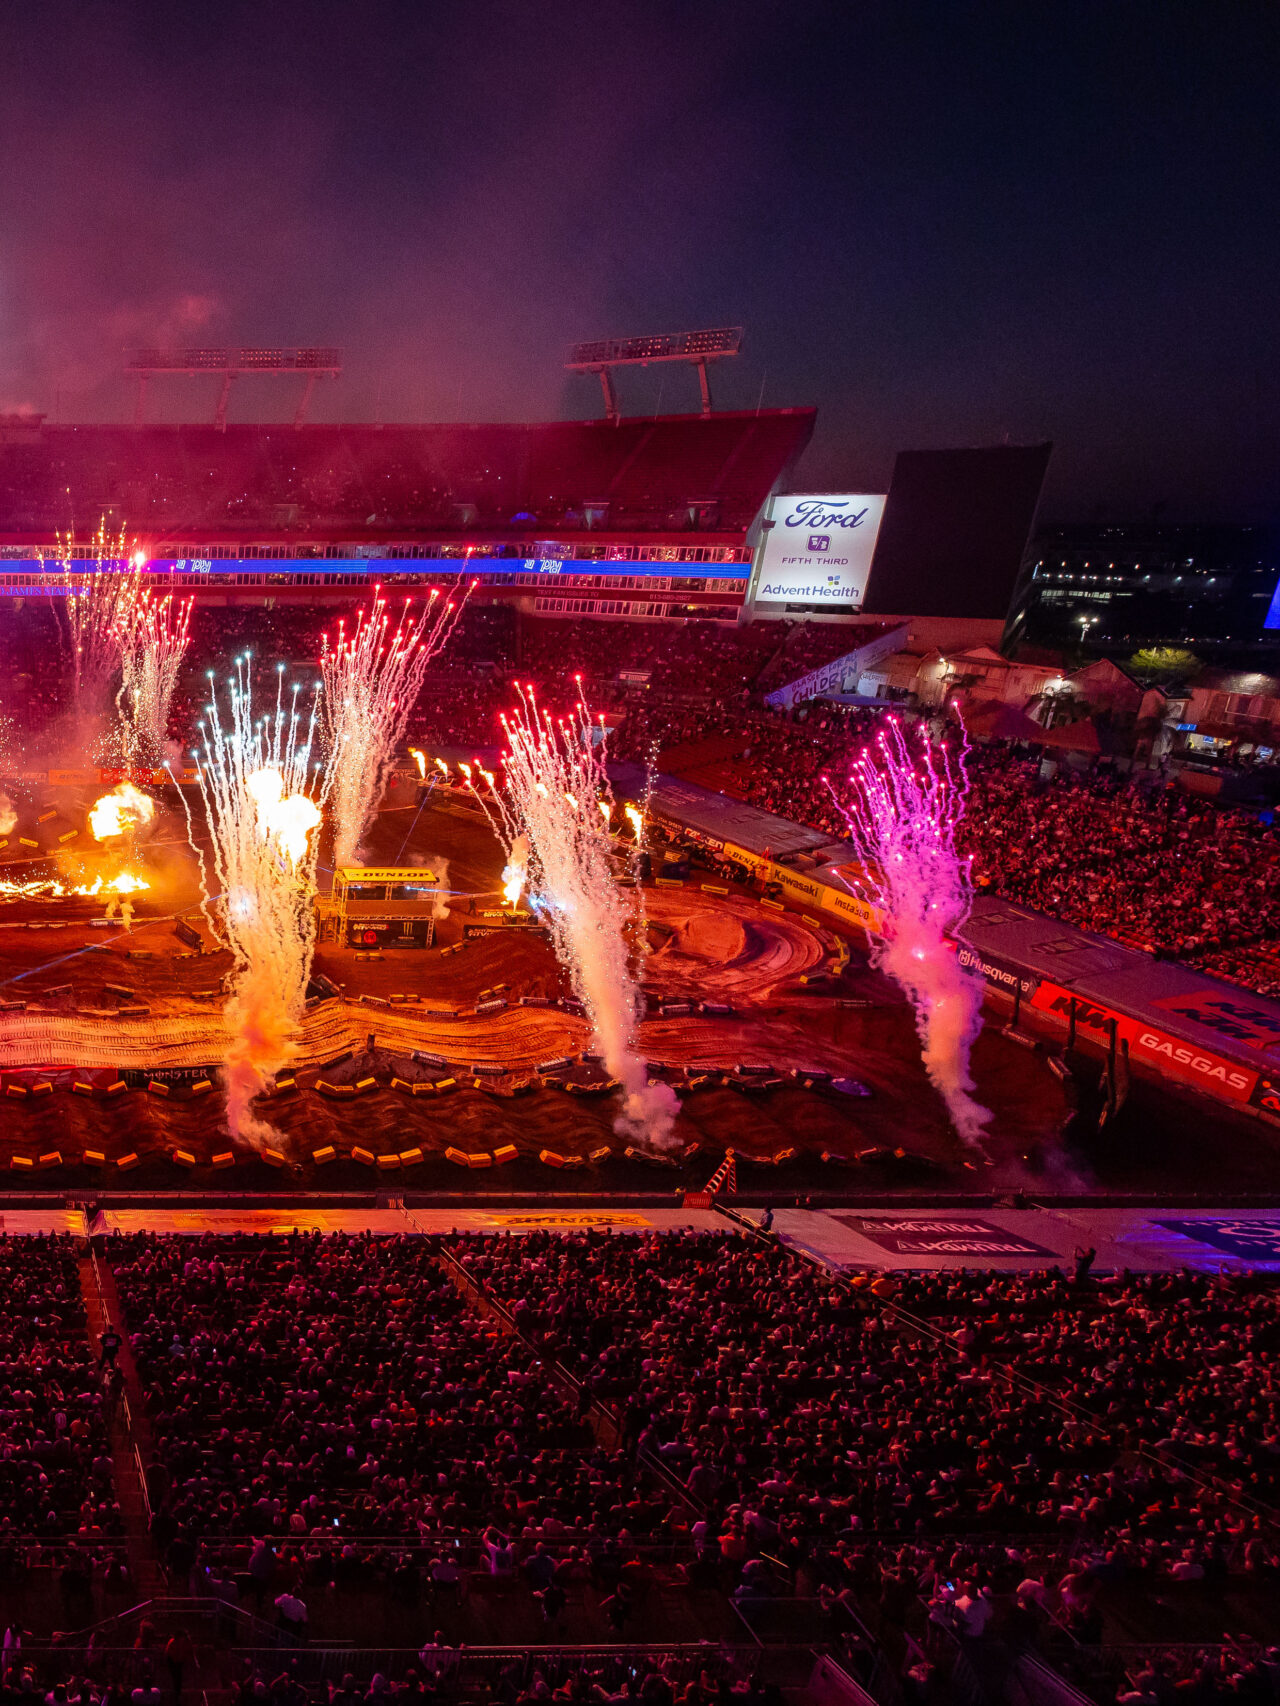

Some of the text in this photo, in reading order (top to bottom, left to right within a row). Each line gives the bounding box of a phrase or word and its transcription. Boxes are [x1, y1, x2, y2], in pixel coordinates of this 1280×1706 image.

[785, 501, 869, 528] Ford
[782, 557, 812, 565] FIFTH
[7, 586, 41, 596] JAMES
[762, 584, 859, 598] AdventHealth
[774, 869, 819, 898] Kawasaki
[1049, 996, 1114, 1035] KTM
[1139, 1033, 1249, 1090] GASGAS
[143, 1069, 209, 1080] MONSTER
